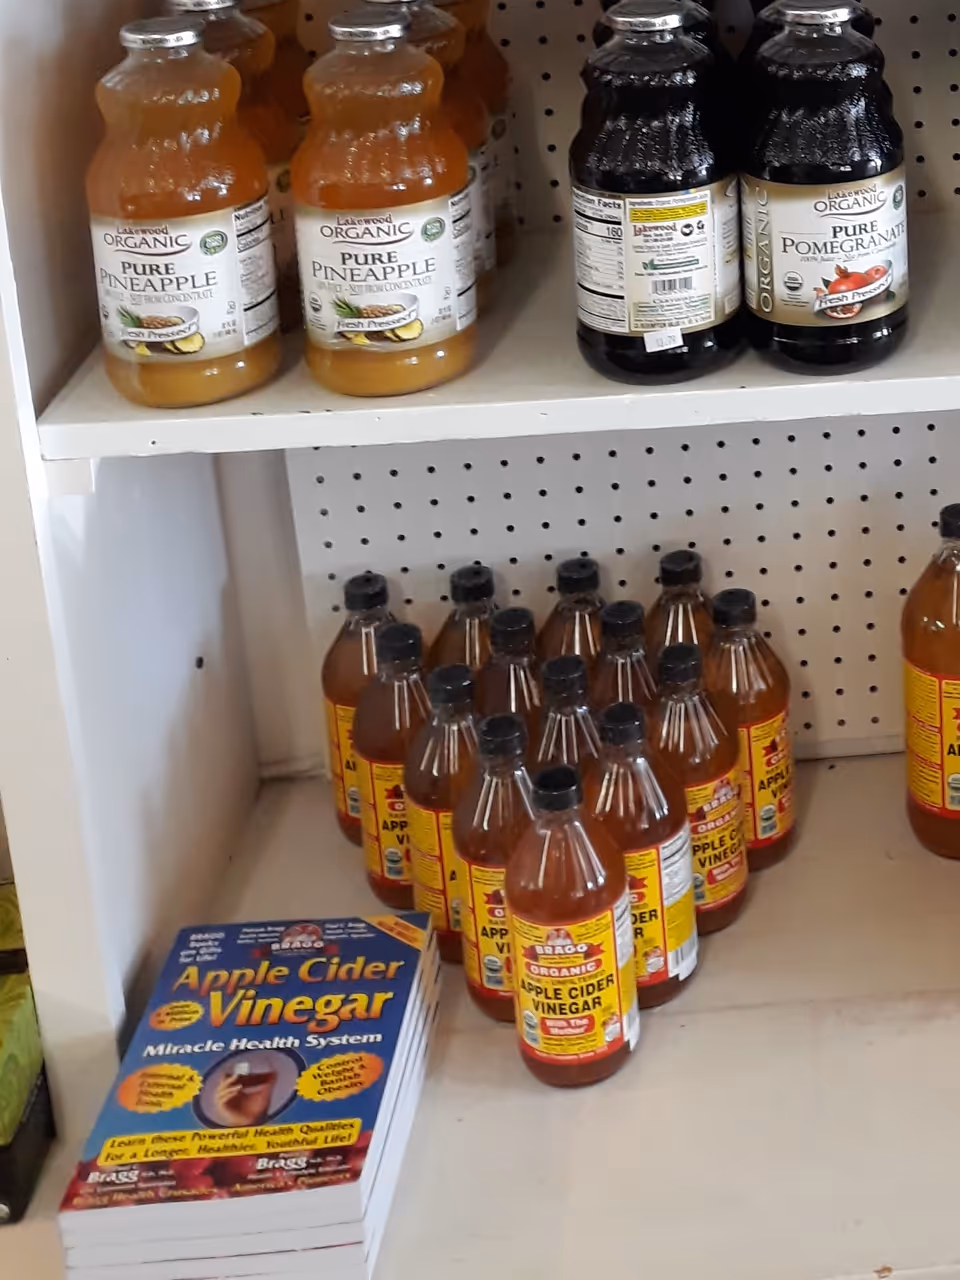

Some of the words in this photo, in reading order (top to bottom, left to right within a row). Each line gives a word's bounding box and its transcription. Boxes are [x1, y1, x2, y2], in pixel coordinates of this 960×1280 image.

[597, 199, 623, 210] Facts
[813, 190, 887, 213] ORGANIC
[336, 213, 394, 226] Lakewood
[116, 225, 169, 236] Lakewood
[320, 222, 413, 239] ORGANIC
[780, 220, 905, 255] POMEGRANATE
[831, 220, 879, 239] PURE
[103, 233, 190, 249] ORGANIC
[755, 186, 774, 313] ORGANIC
[340, 250, 399, 266] PURE
[121, 261, 176, 276] PURE
[312, 257, 437, 283] PINEAPPLE
[100, 267, 218, 293] PINEAPPLE
[818, 294, 849, 308] Fresh
[336, 320, 364, 330] Fresh
[535, 943, 588, 955] BRAGG
[172, 959, 290, 997] Apple
[298, 955, 406, 984] Cider
[530, 961, 597, 977] ORGANIC
[521, 978, 563, 1000] APPLE
[568, 973, 615, 1000] CIDER
[208, 988, 395, 1034] Vinegar
[532, 995, 603, 1016] VINEGAR
[143, 1040, 225, 1058] Miracle
[229, 1036, 300, 1051] Health
[304, 1032, 383, 1050] System
[316, 1056, 365, 1071] Control
[311, 1065, 354, 1080] Weight
[318, 1073, 362, 1087] Banish
[316, 1080, 365, 1097] Obesity
[109, 1137, 147, 1149] Learn
[190, 1127, 250, 1144] Powerful
[253, 1125, 294, 1138] Health
[298, 1120, 356, 1136] Qualities
[129, 1152, 138, 1160] a
[265, 1136, 318, 1150] Youthful
[323, 1132, 353, 1145] Life!
[254, 1156, 308, 1171] Bragg
[86, 1169, 140, 1184] Bragg
